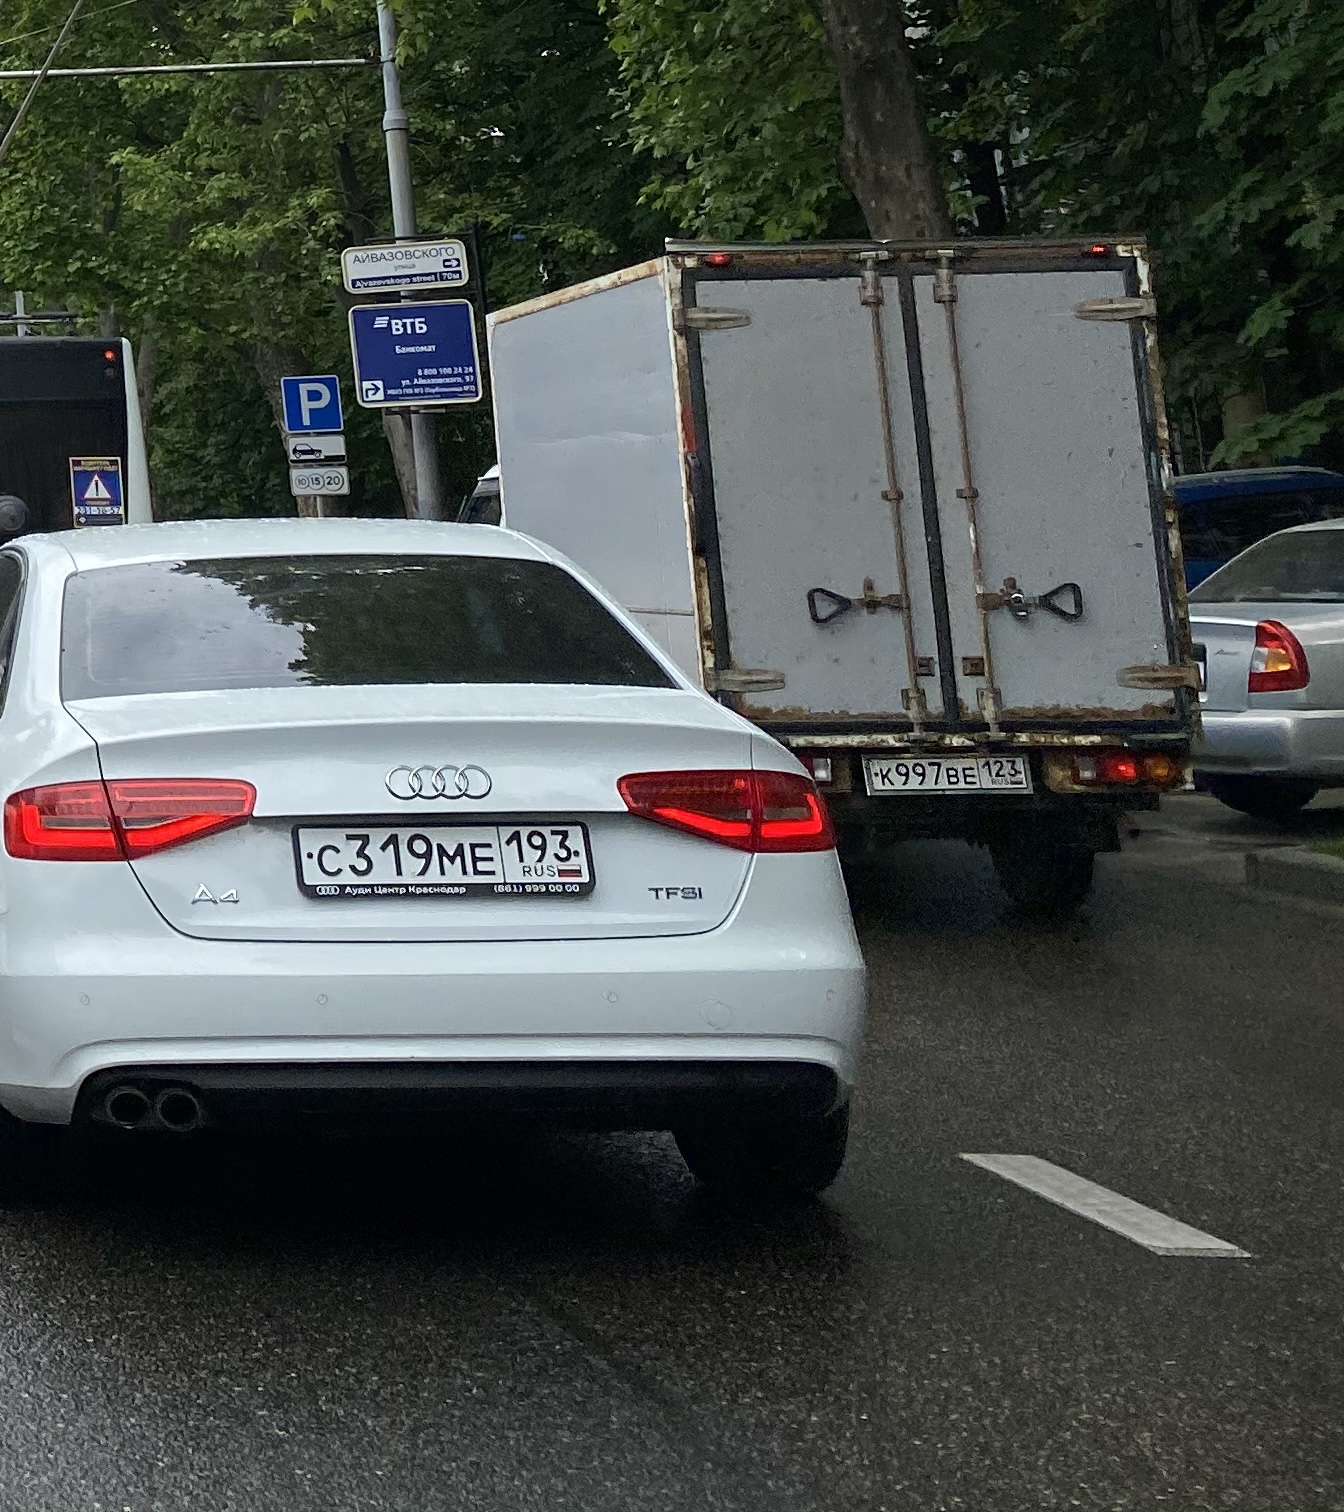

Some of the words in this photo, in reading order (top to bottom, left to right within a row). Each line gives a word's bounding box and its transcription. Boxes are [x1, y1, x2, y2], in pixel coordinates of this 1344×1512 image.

[352, 246, 456, 265] АЙВАЗОВСКОГО
[393, 263, 416, 271] улица
[411, 273, 436, 283] street
[391, 317, 428, 335] ВТБ
[395, 345, 436, 354] Банкомат
[298, 478, 307, 486] 10
[311, 476, 321, 485] 15
[326, 475, 341, 485] 20
[981, 759, 1018, 778] 123
[505, 829, 572, 863] 193
[522, 865, 556, 877] RUS
[191, 883, 239, 904] A4
[345, 886, 372, 896] Ауди
[373, 885, 407, 895] Центр
[408, 885, 466, 896] Краснодар
[548, 884, 563, 893] 00
[564, 884, 580, 893] 00
[648, 887, 702, 900] TFSI
